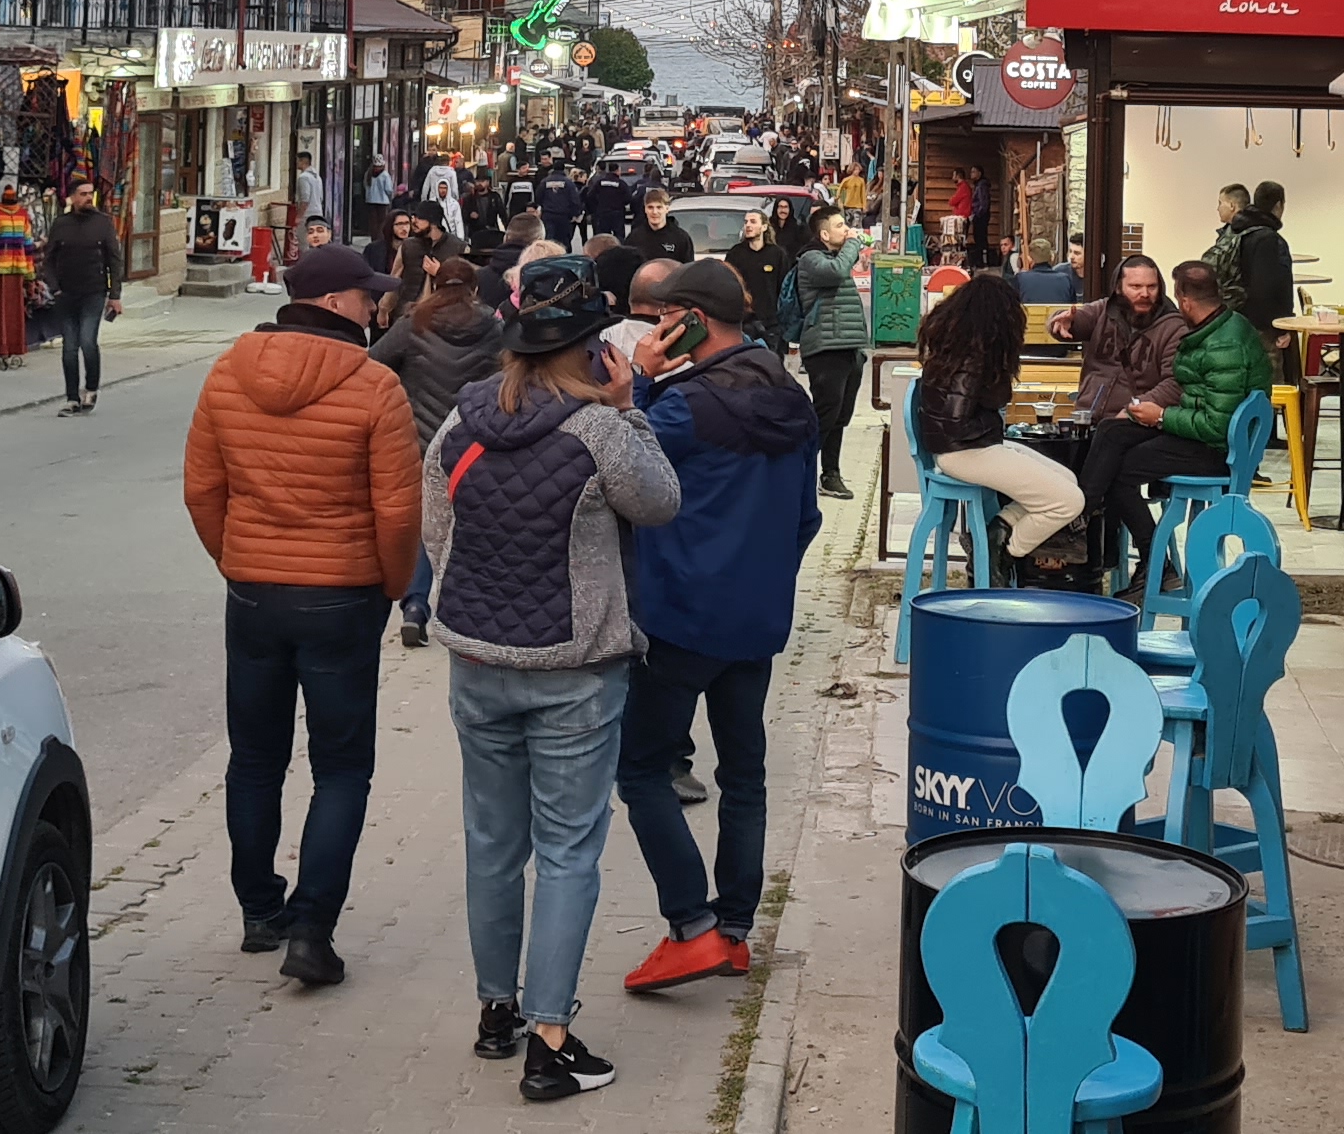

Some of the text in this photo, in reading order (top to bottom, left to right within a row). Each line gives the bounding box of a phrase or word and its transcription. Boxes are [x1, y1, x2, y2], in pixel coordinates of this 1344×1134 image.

[1006, 61, 1072, 81] COSTA
[1020, 80, 1057, 90] COFFEE
[913, 801, 934, 818] BORN
[938, 811, 950, 822] IN
[955, 813, 980, 827] SAN
